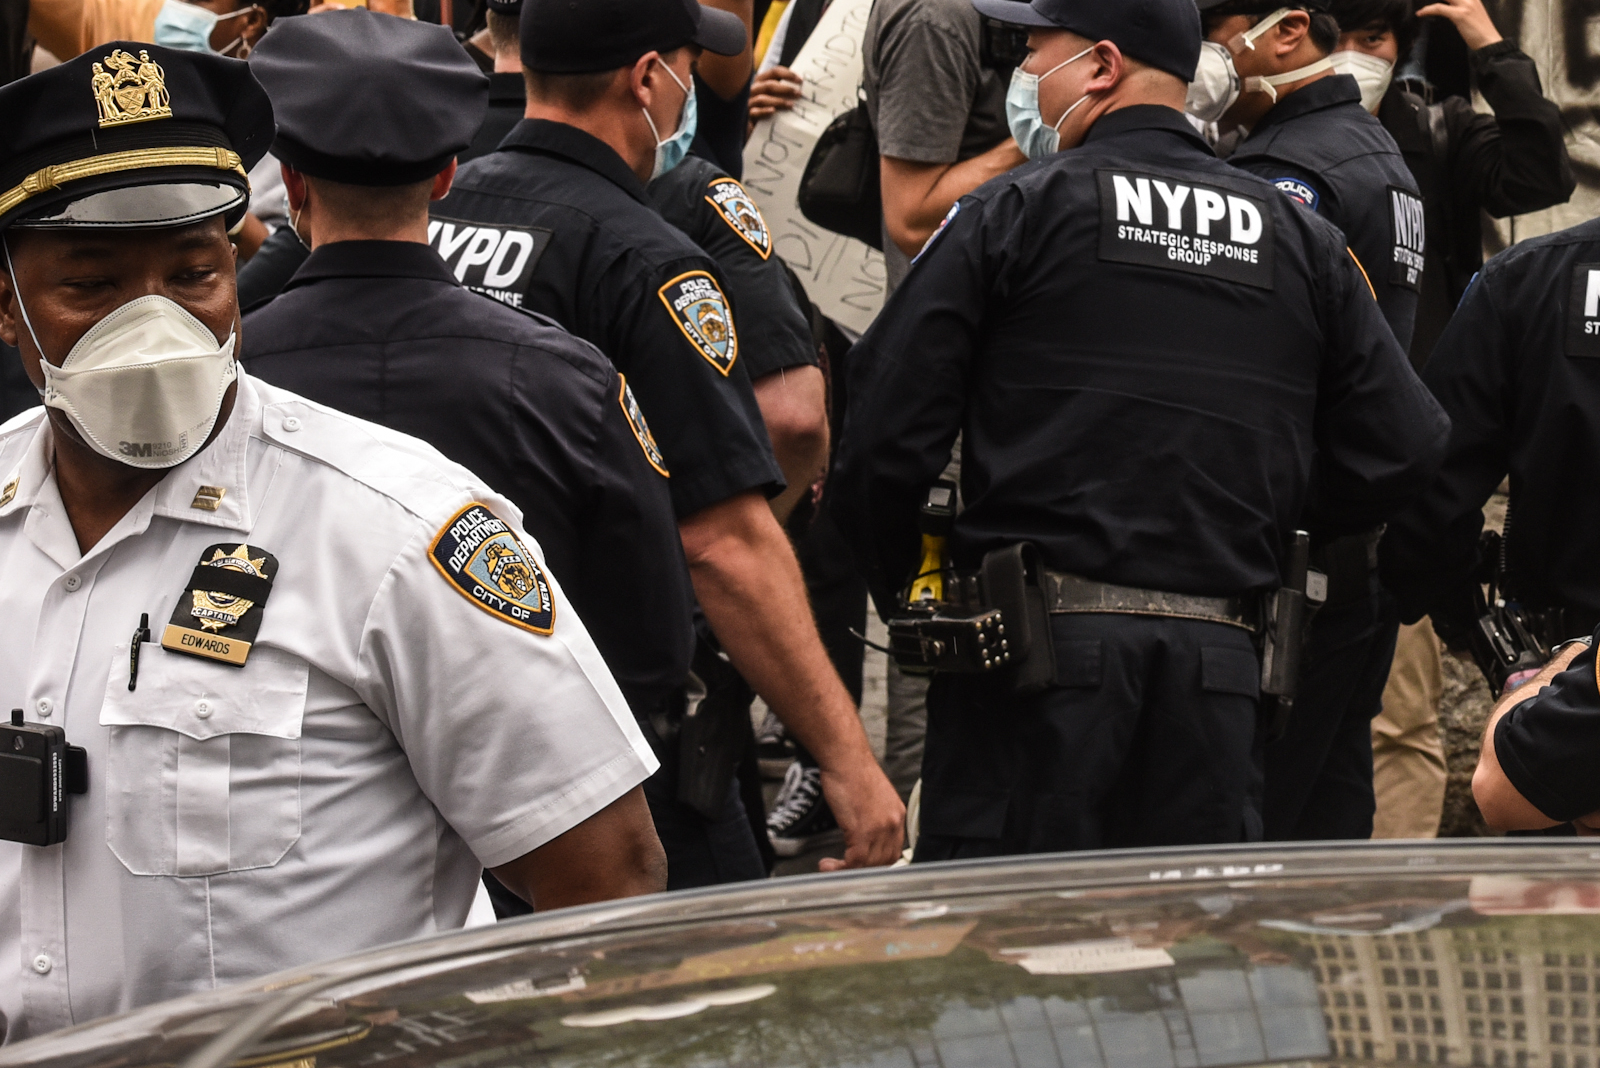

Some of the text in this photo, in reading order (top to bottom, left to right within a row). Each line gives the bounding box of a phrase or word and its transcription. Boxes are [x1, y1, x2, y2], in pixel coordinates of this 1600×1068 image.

[745, 122, 803, 196] NOT
[1112, 175, 1263, 245] NYPD
[1392, 190, 1425, 253] NYPD
[1118, 225, 1259, 264] STRATEGIC RESPONSE
[1167, 247, 1212, 267] GROUP
[119, 441, 152, 457] 3M
[153, 447, 180, 457] NIOSH
[450, 508, 488, 543] POLICE
[448, 519, 508, 573] DEPARTMENT
[473, 585, 530, 620] CITY OF
[538, 580, 551, 612] NEW
[195, 607, 234, 623] CAPTAIN
[181, 634, 230, 654] EDWARDS
